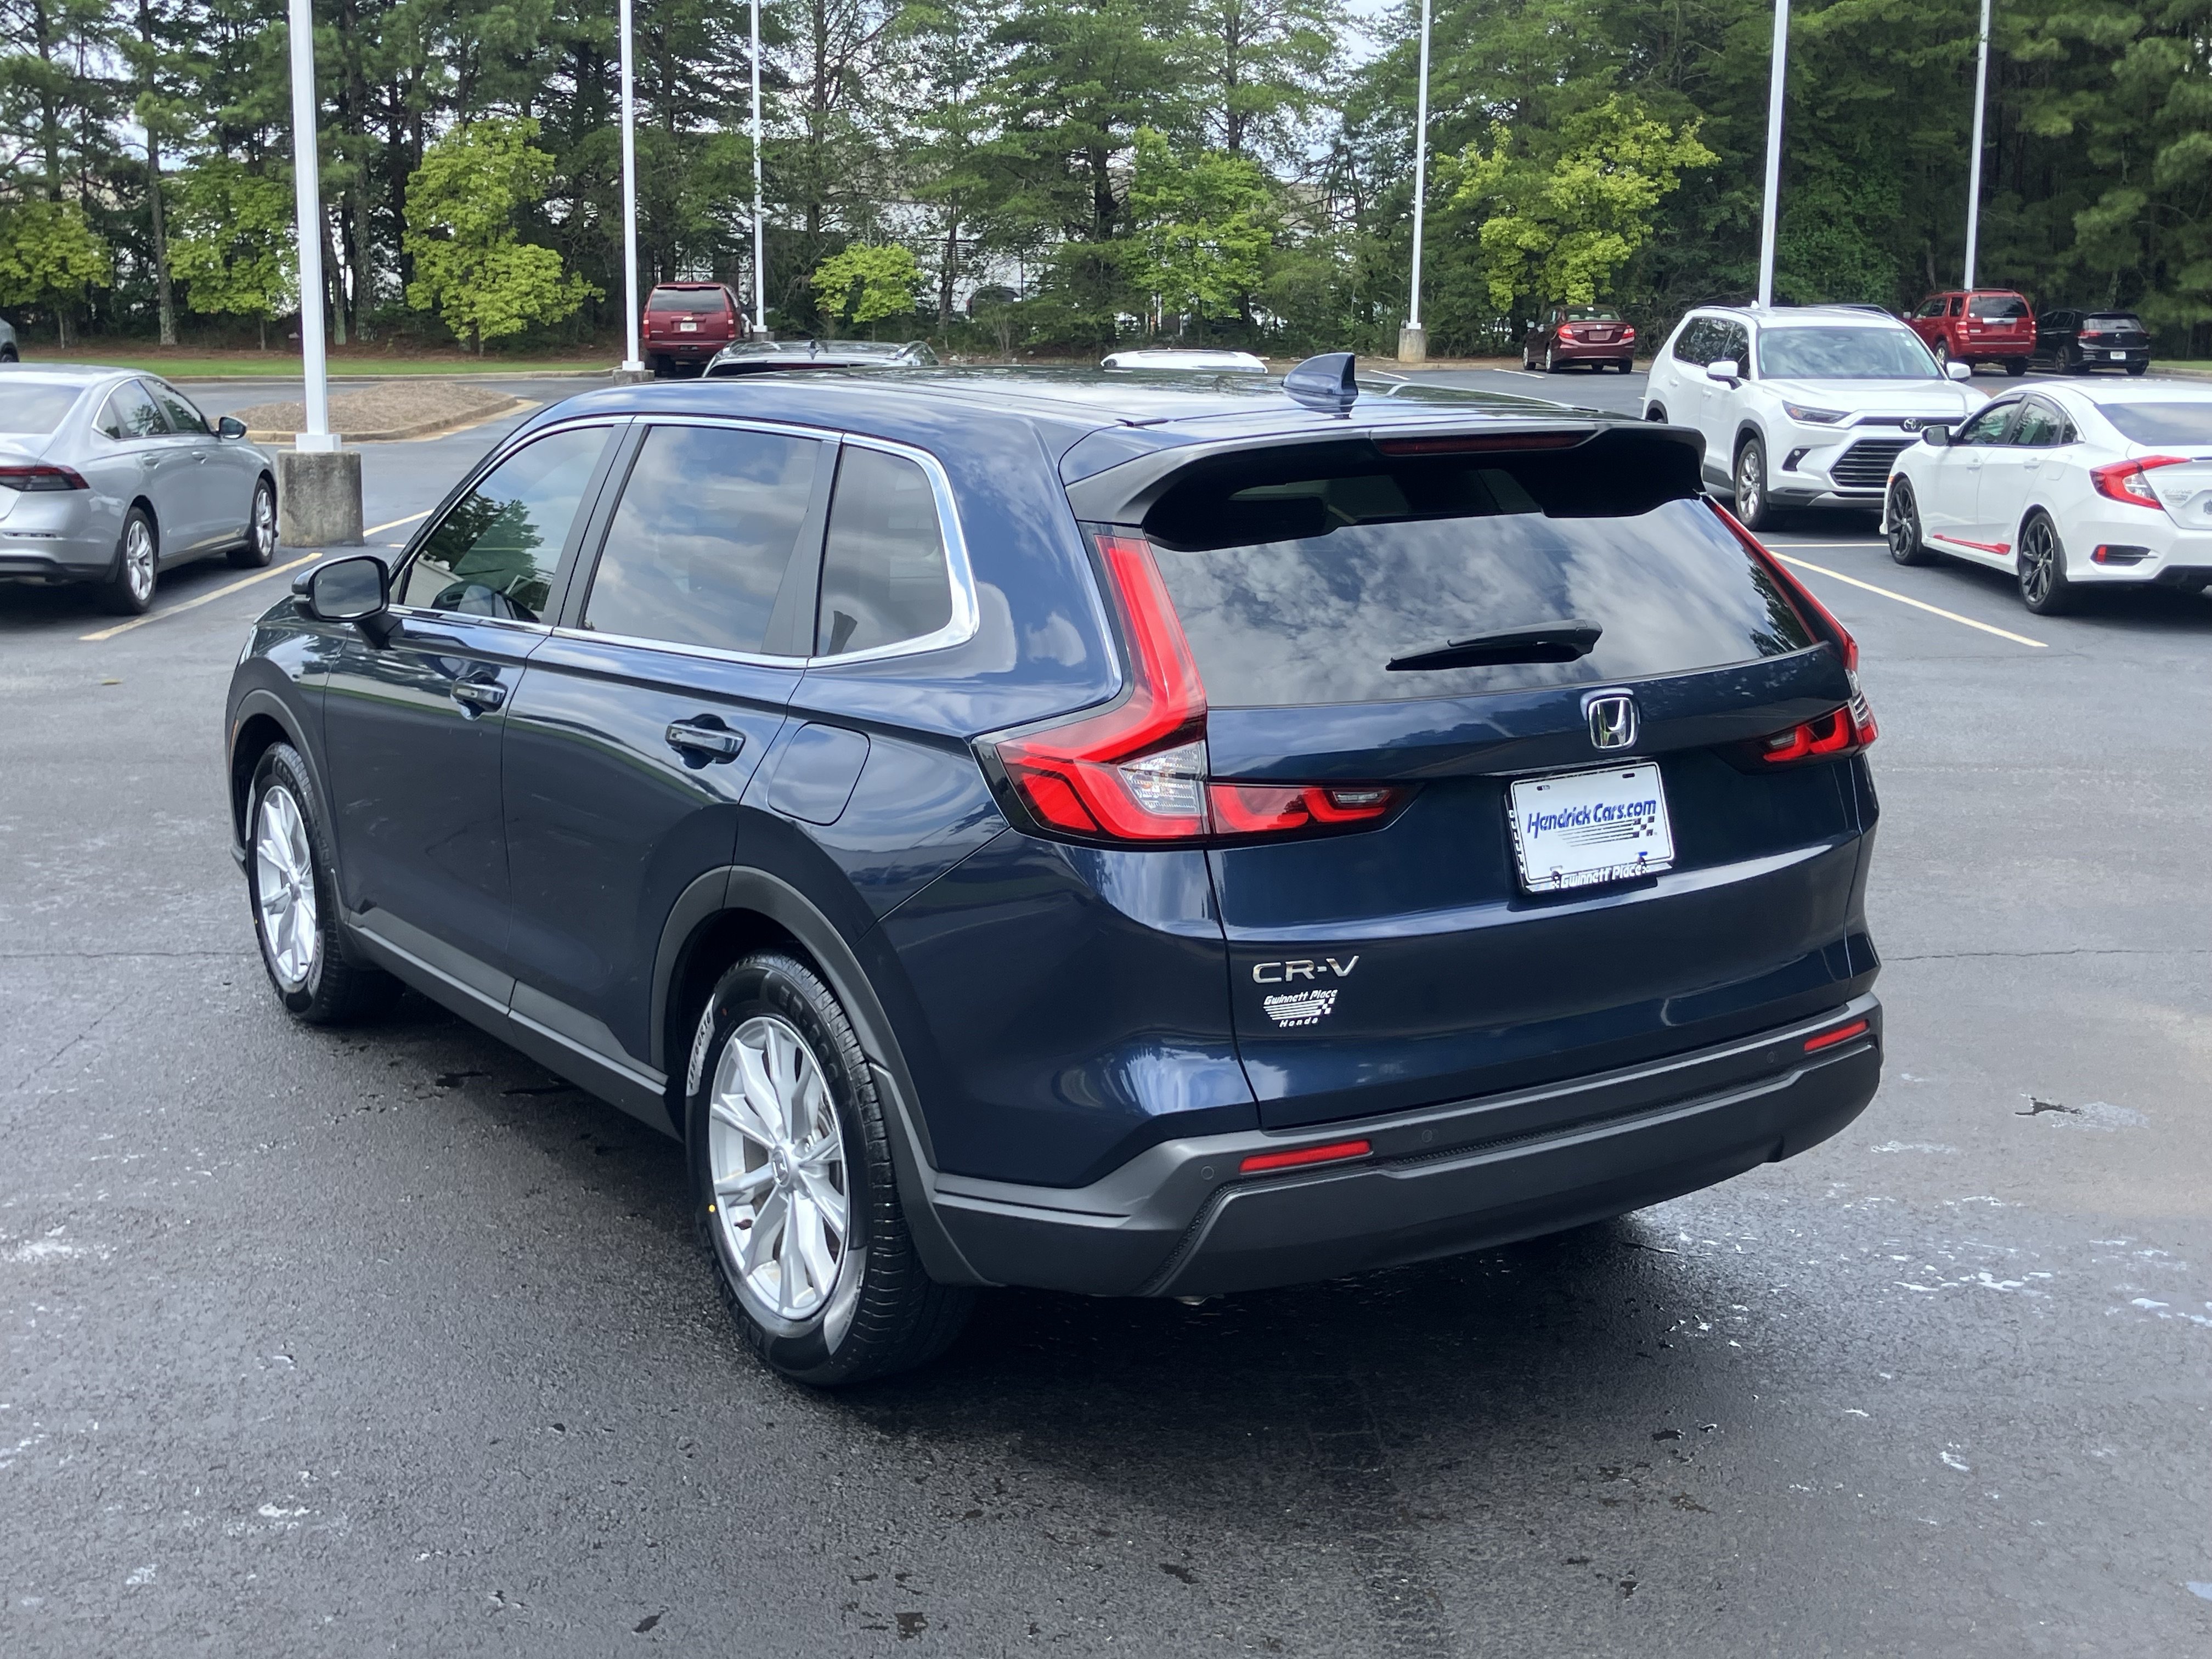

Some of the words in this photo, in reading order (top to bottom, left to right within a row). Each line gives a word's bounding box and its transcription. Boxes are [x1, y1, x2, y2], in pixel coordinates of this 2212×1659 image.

[1560, 866, 1612, 888] Gwinnett
[1612, 864, 1641, 880] Place
[1252, 955, 1359, 984] CR-V
[1263, 991, 1308, 1005] Gwinnett
[1309, 989, 1338, 1000] Place
[1278, 1017, 1318, 1028] Honda
